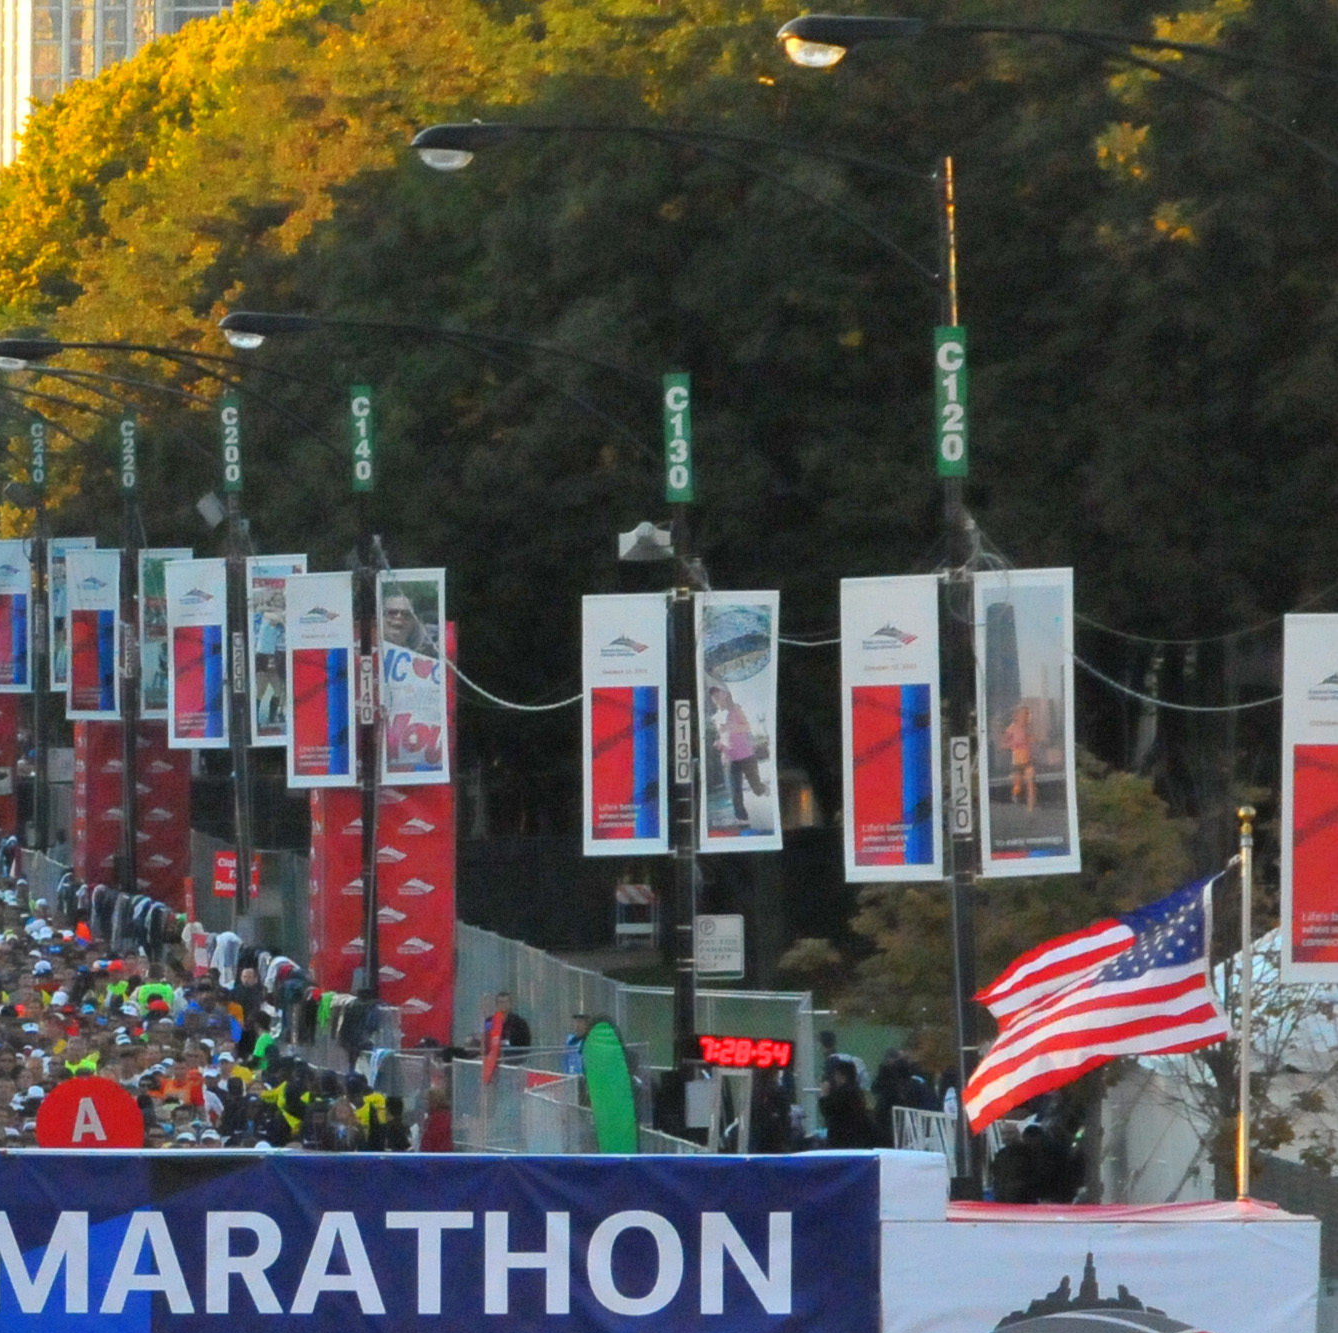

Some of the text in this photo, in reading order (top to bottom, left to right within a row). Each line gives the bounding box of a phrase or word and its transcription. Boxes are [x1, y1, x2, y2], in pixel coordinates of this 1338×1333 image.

[350, 395, 373, 481] C140
[665, 386, 689, 490] C130
[936, 342, 965, 463] C120
[30, 422, 45, 484] C240
[119, 420, 136, 488] C220
[221, 406, 241, 483] C200
[361, 658, 373, 722] C140
[676, 704, 690, 780] C130
[952, 739, 969, 830] C120
[71, 1097, 107, 1142] A
